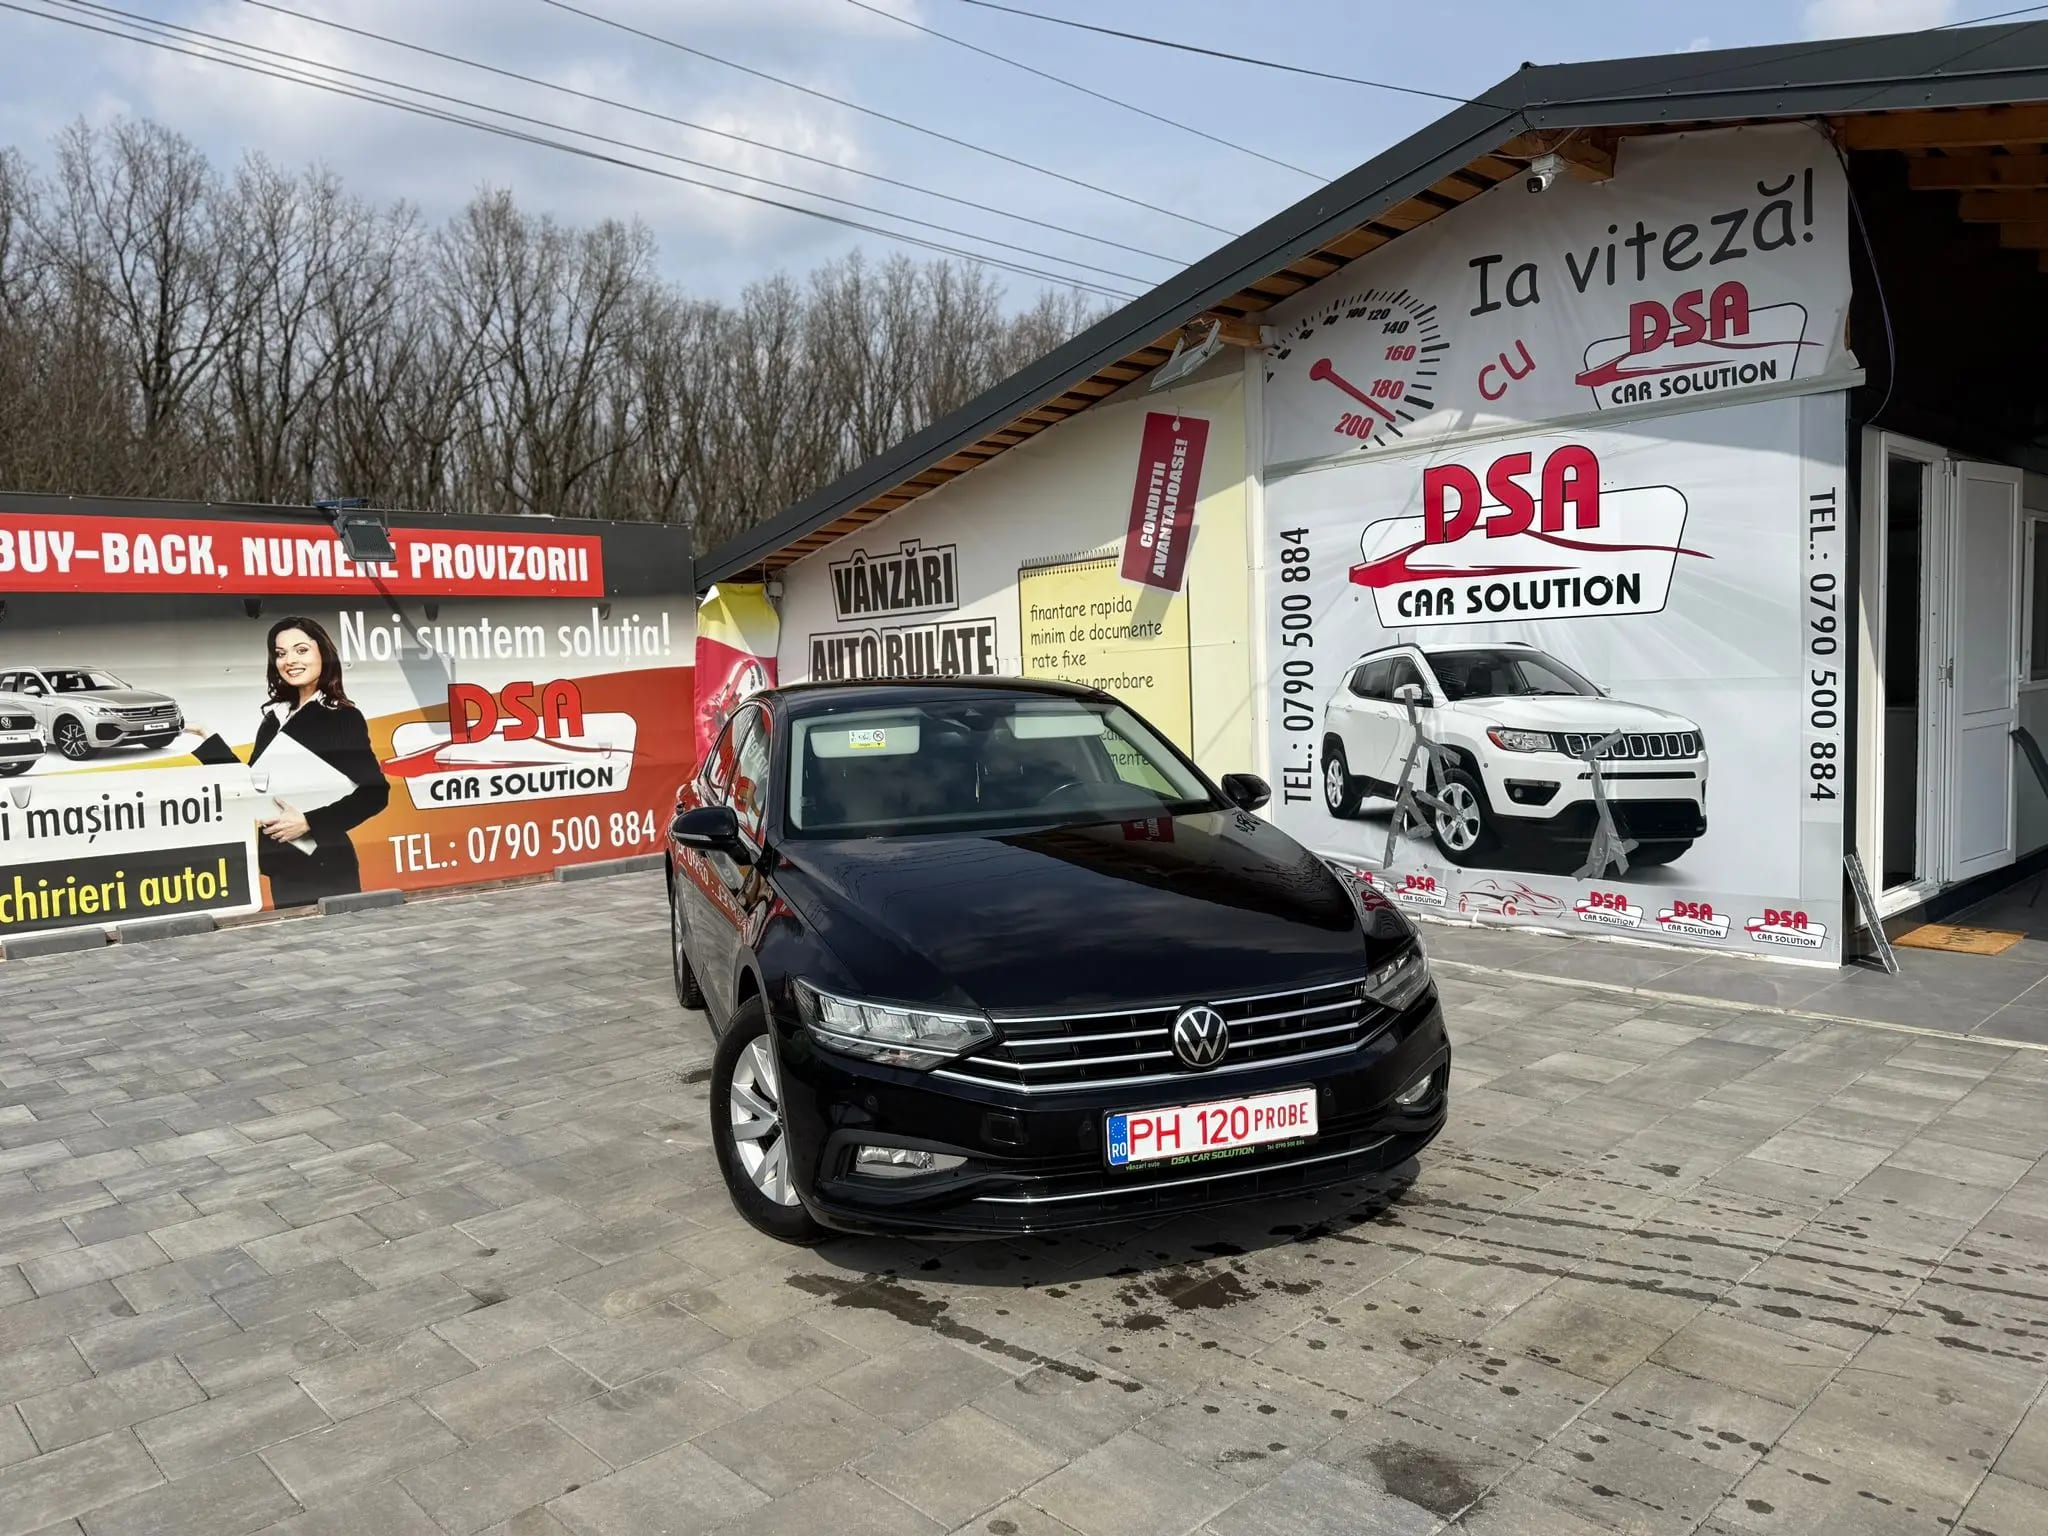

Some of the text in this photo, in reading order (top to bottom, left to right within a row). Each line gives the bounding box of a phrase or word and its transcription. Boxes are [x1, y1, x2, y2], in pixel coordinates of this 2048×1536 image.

[1469, 167, 1813, 316] Ia viteză!
[1346, 307, 1367, 319] 100
[1367, 308, 1391, 320] 120
[1382, 320, 1410, 334] 140
[1630, 280, 1749, 355] DSA
[1384, 345, 1417, 361] 160
[1479, 339, 1536, 400] cu
[1369, 378, 1405, 400] 180
[1611, 359, 1777, 404] CAR SOLUTION
[1333, 412, 1375, 440] 200
[1140, 461, 1166, 548] CONDITII
[1153, 438, 1188, 578] AVANTAJOASE!
[1423, 444, 1600, 545] DSA
[0, 529, 227, 578] BUY-BACK,
[410, 542, 589, 582] PROVIZORII
[1280, 527, 1310, 583] 884
[834, 547, 954, 614] VÂNZĂRI
[1398, 573, 1640, 618] CAR SOLUTION
[1030, 595, 1132, 622] finantare rapida
[1281, 594, 1313, 648] 500
[1810, 573, 1837, 656] 0790
[339, 611, 401, 662] Noi
[417, 617, 545, 661] suntem
[885, 626, 993, 676] RULATE
[1030, 620, 1163, 646] minim de documente
[1032, 649, 1087, 669] rate fixe
[1093, 671, 1154, 690] aprobare
[448, 679, 584, 744] DSA
[1283, 660, 1314, 731] 0790
[1811, 669, 1837, 729] 500
[430, 767, 613, 801] CAR SOLUTION
[1810, 742, 1837, 801] 884
[27, 791, 145, 843] mașini
[160, 784, 223, 827] noi!
[388, 809, 656, 873] TEL.: 0790 500 884
[139, 858, 229, 907] auto!
[1406, 875, 1436, 892] DSA
[1414, 896, 1442, 905] SOLUTION
[1590, 891, 1627, 911] DSA
[1598, 914, 1635, 926] SOLUTION
[1667, 924, 1722, 937] CAR SOLUTION
[1673, 900, 1713, 921] DSA
[1764, 909, 1808, 930] DSA
[1757, 933, 1816, 946] CAR SOLUTION
[1112, 1142, 1127, 1158] RO
[1129, 1102, 1309, 1155] PH 120 PROBE
[1171, 1146, 1255, 1166] DSA CAR SOLUTION
